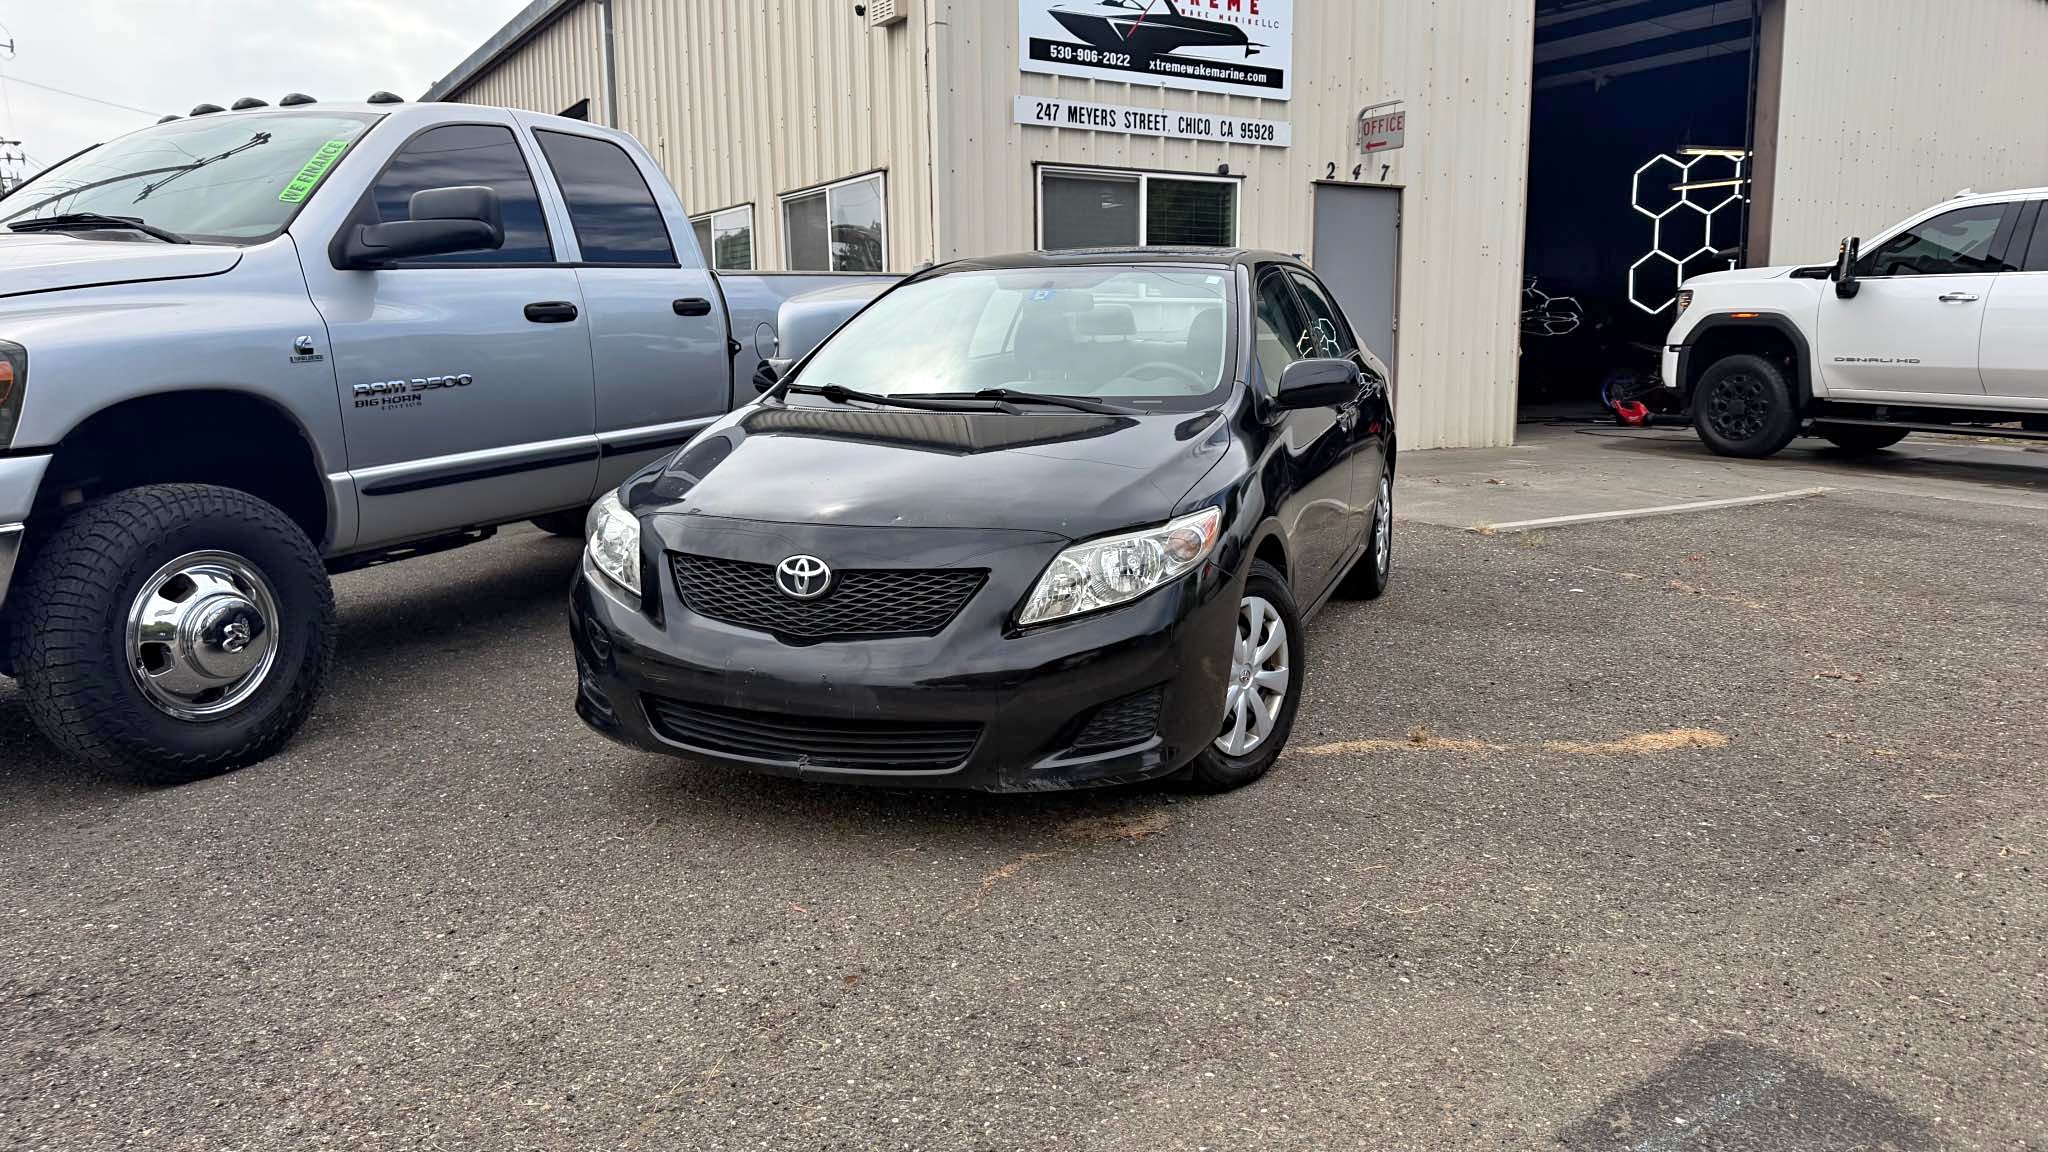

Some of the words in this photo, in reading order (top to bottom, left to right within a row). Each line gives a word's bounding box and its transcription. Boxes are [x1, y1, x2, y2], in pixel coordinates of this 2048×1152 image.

[1050, 45, 1131, 67] 530-906-2022
[1148, 59, 1267, 83] xtremewakemarine.com
[1036, 102, 1060, 121] 247
[1067, 105, 1117, 127] MEYERS
[1124, 111, 1170, 133] STREET,
[1220, 120, 1234, 137] CA
[1240, 122, 1274, 141] 95928
[1363, 115, 1403, 136] OFFICE
[281, 183, 305, 200] WE
[296, 143, 344, 183] FINANCE
[353, 380, 406, 397] RAM
[411, 373, 473, 391] 3500
[355, 399, 379, 408] BIG
[382, 393, 422, 405] HORN
